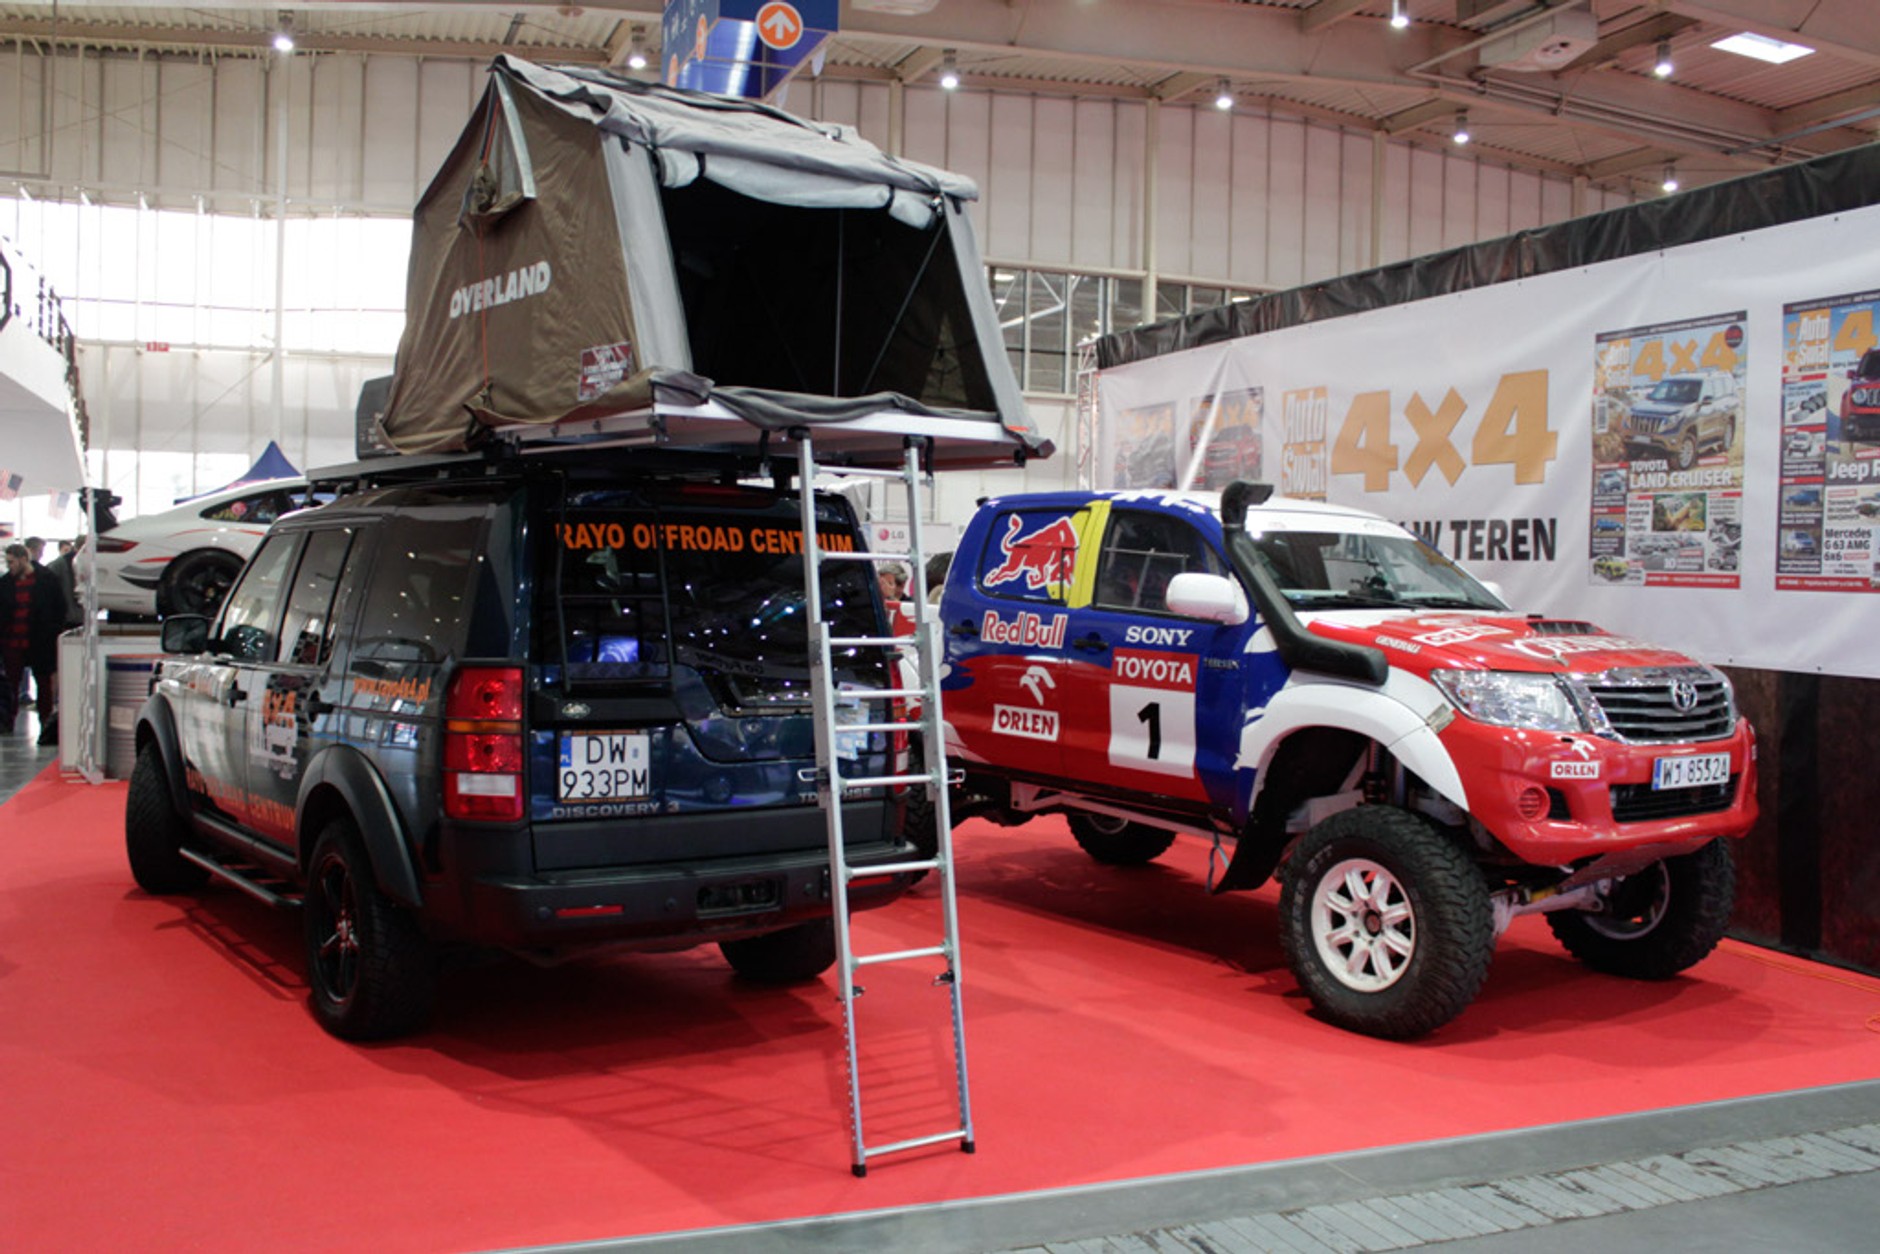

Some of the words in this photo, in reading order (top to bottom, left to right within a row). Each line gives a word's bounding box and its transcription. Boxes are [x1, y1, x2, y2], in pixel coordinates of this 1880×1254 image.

[449, 260, 552, 319] OVERLAND
[1629, 471, 1667, 488] LAND
[1669, 468, 1733, 487] CRUISER
[1630, 459, 1669, 472] TOYOTA
[1828, 460, 1870, 482] Jeep
[555, 522, 625, 549] RAYO
[632, 523, 745, 552] OFFROAD
[891, 530, 905, 540] LG
[1450, 518, 1557, 561] TEREN
[1824, 528, 1872, 539] Mercedes
[1833, 540, 1845, 550] 63
[1847, 540, 1871, 550] AMG
[981, 610, 1025, 644] Red
[1022, 613, 1069, 649] Bull
[1125, 626, 1194, 646] SONY
[1115, 656, 1193, 684] TOYOTA
[997, 708, 1056, 736] ORLEN
[1137, 701, 1161, 760] 1
[586, 736, 627, 764] DW
[1554, 763, 1596, 776] ORLEN
[563, 769, 648, 799] 933PM
[552, 802, 660, 819] DISCOVERY
[667, 801, 680, 813] 3
